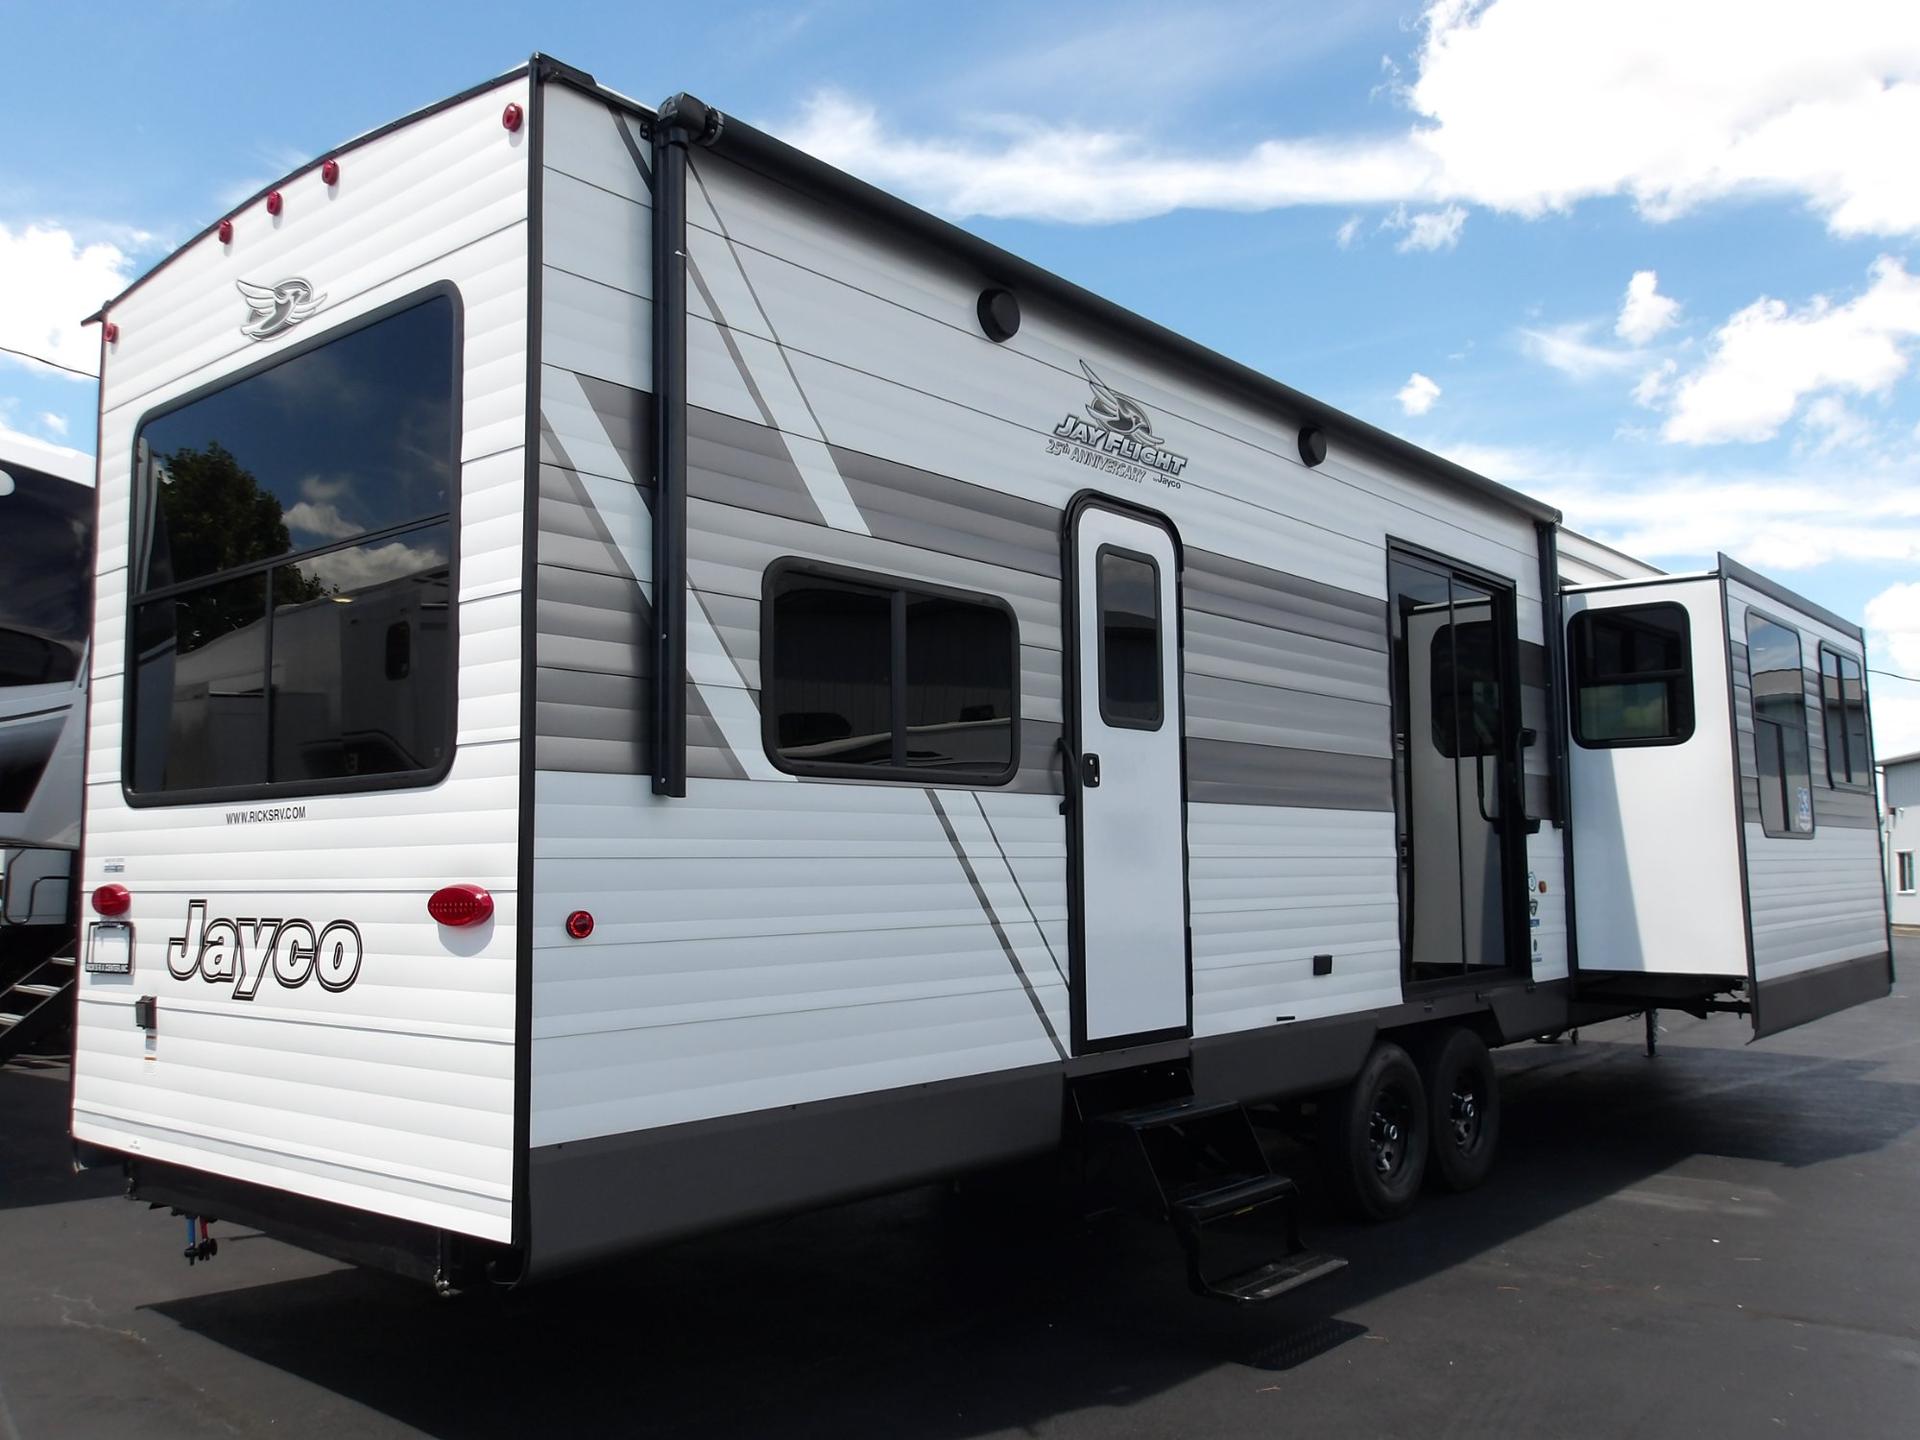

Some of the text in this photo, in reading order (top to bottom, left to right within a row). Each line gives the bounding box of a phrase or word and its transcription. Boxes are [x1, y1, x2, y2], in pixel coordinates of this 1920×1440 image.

[1053, 414, 1187, 475] JAY FLIGHT
[1070, 446, 1147, 484] ANNIVERSARY
[1158, 473, 1181, 489] Jayco
[226, 806, 306, 824] WWW.RICKSRV.COM
[168, 899, 363, 1001] Jayco
